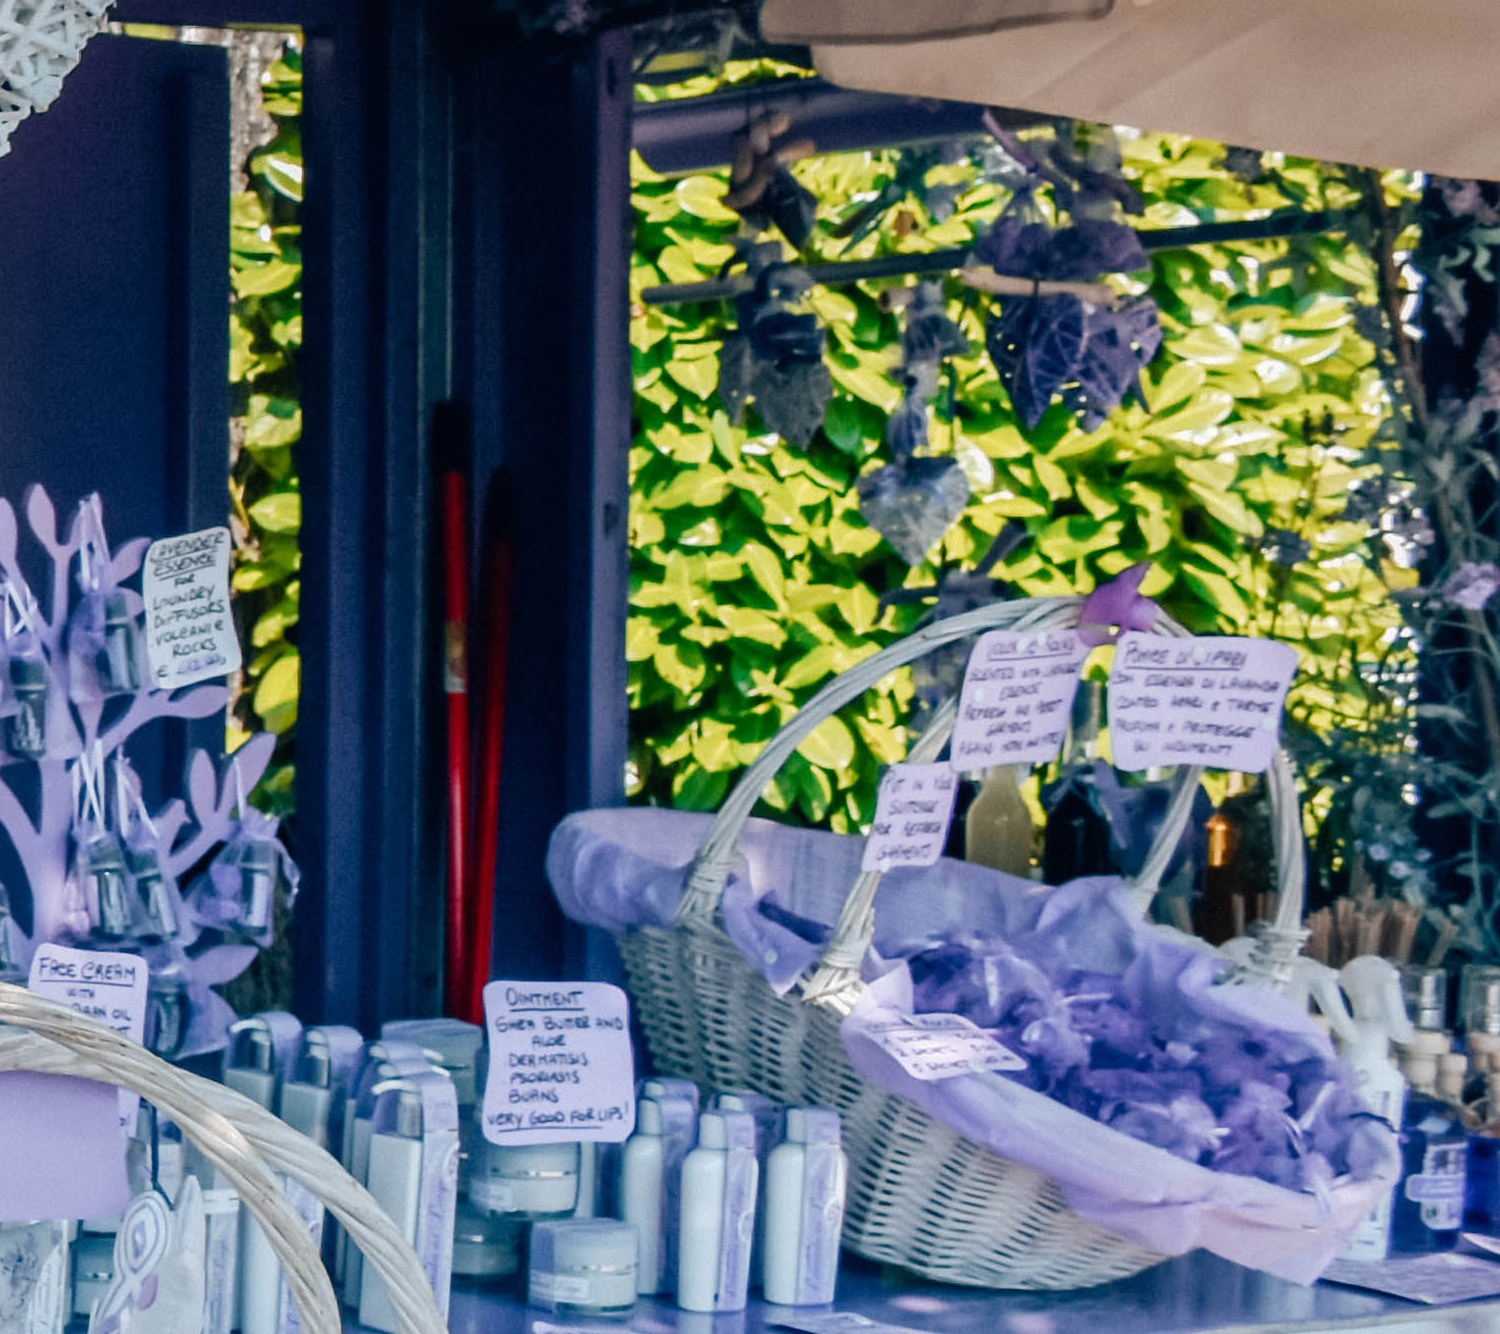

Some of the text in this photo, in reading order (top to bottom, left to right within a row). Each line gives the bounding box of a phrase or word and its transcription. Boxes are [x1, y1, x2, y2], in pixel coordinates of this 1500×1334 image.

[39, 956, 136, 983] FACE CREAM
[506, 988, 584, 1006] OINTMENT
[571, 1107, 594, 1122] FOR
